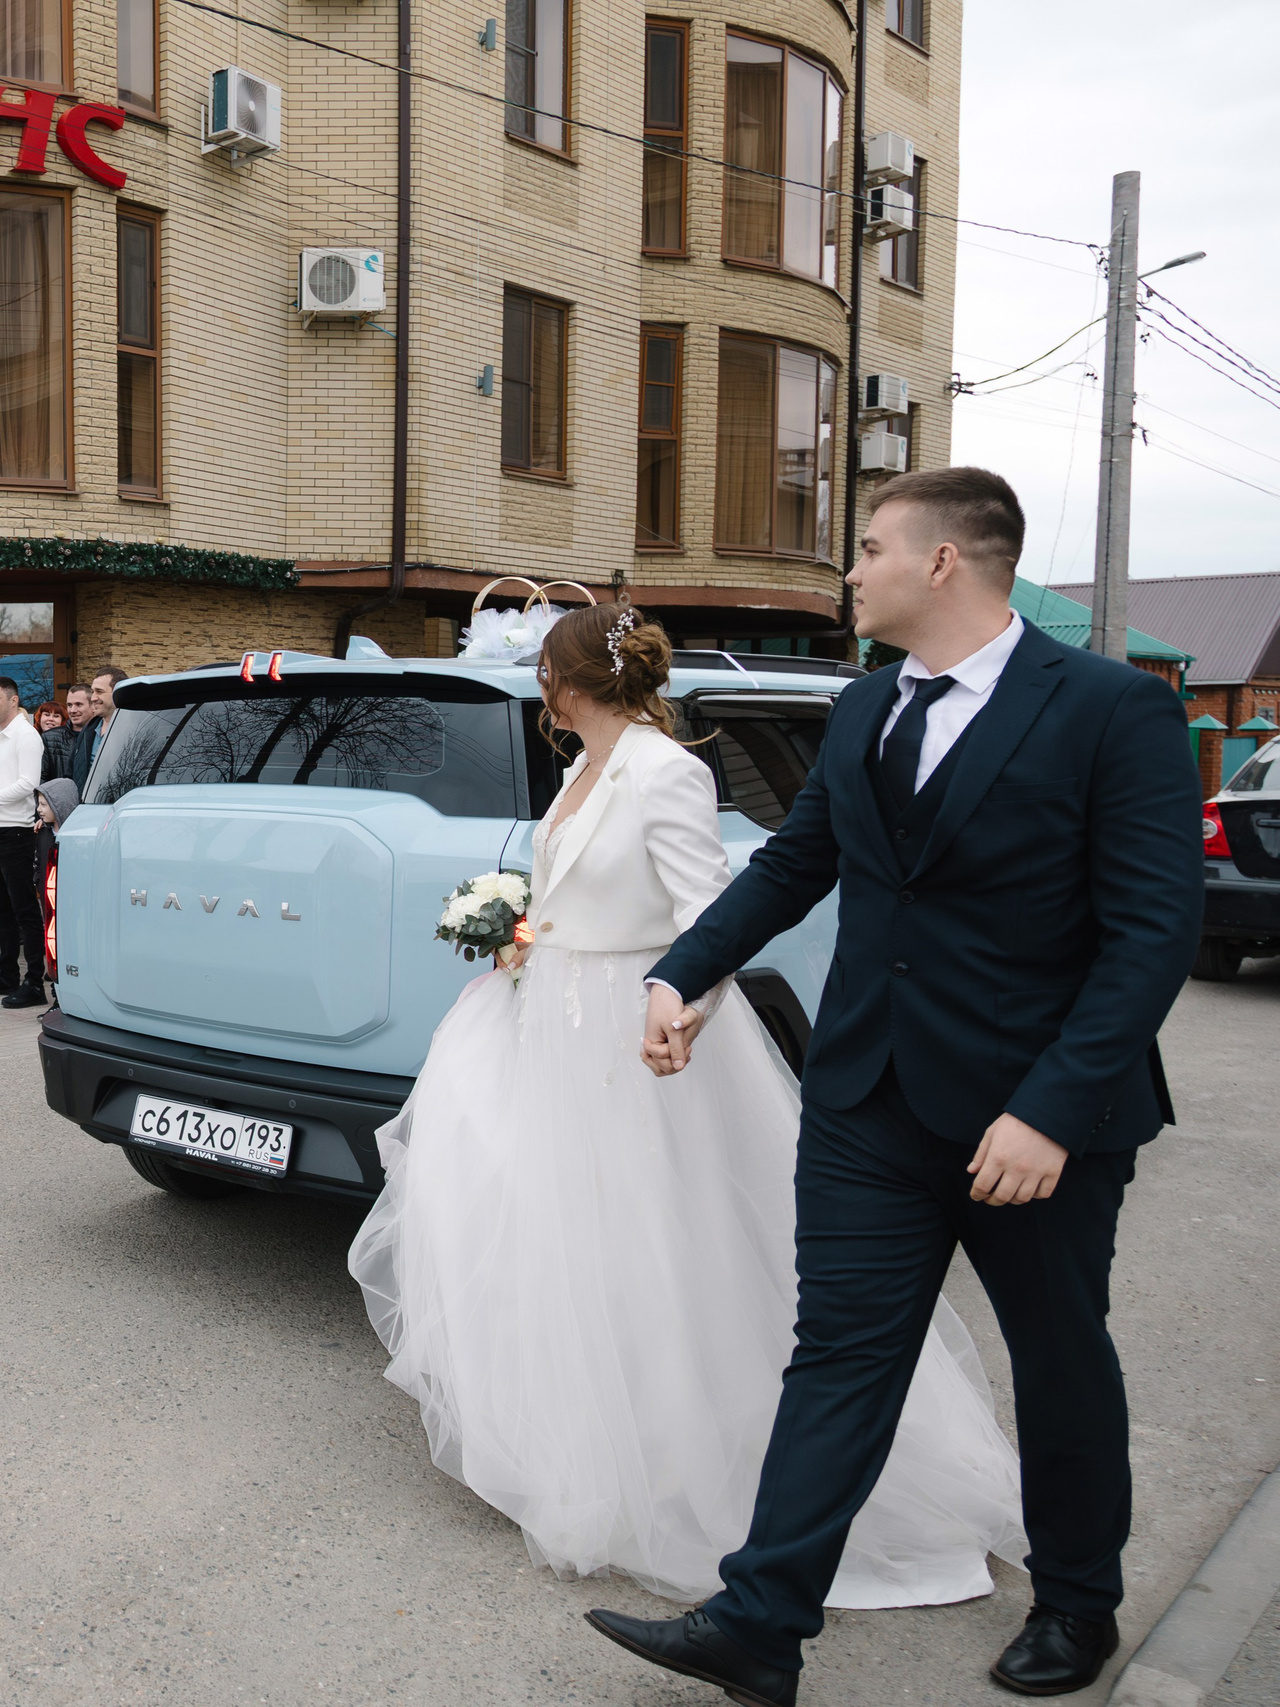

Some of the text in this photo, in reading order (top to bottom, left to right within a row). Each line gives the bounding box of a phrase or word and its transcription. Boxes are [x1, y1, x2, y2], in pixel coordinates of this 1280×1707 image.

[130, 888, 302, 922] HAVAL
[185, 1148, 218, 1162] HAVAL
[248, 1148, 269, 1161] RUS
